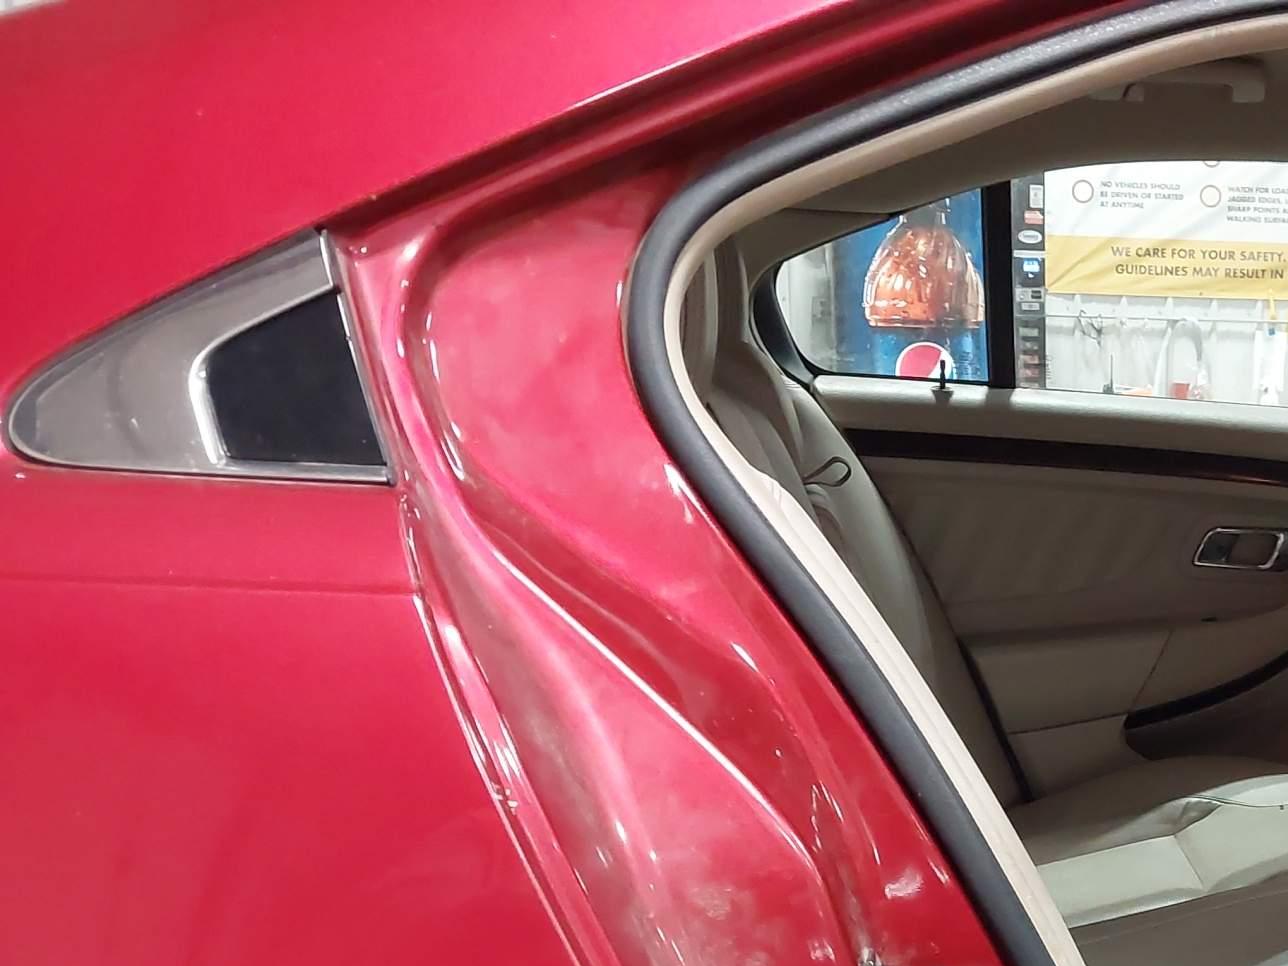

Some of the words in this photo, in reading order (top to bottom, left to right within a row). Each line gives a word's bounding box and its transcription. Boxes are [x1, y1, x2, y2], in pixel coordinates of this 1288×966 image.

[1100, 180, 1112, 188] NO
[1150, 183, 1181, 191] SHOULD
[1154, 193, 1184, 201] STARTED
[1111, 201, 1144, 209] ANYTIME
[1111, 246, 1131, 257] WE
[1135, 247, 1167, 258] CARE
[1171, 248, 1196, 259] FOR
[1200, 249, 1236, 261] YOUR
[1240, 251, 1287, 262] SAFETY.
[1115, 263, 1188, 277] GUIDELINES
[1192, 266, 1220, 278] MAY
[1224, 267, 1266, 279] RESULT
[1269, 269, 1284, 280] IN
